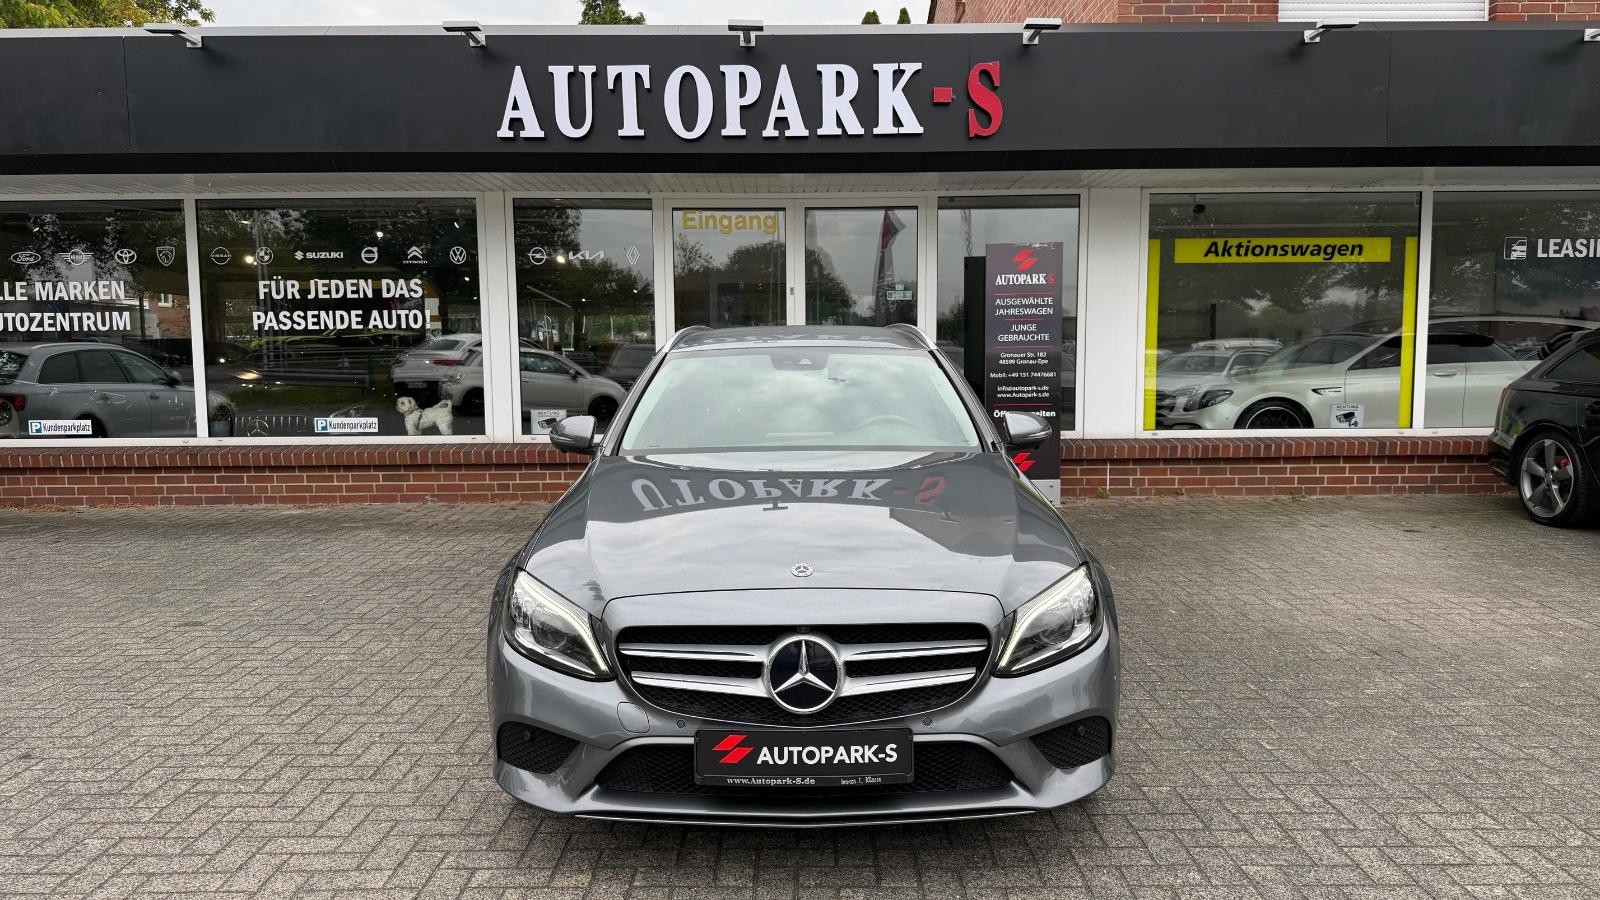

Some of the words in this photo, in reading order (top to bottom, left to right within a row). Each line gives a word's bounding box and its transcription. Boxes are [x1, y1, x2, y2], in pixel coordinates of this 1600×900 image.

[496, 61, 1004, 140] AUTOPARK-S
[682, 209, 778, 234] Eingang
[306, 251, 344, 259] SUZUKI
[1203, 240, 1364, 263] Aktionswagen
[1537, 238, 1600, 258] LEASI
[0, 281, 29, 301] LE
[35, 280, 126, 301] MARKEN
[258, 275, 301, 300] FÜR
[307, 278, 373, 300] JEDEN
[381, 277, 423, 299] DAS
[995, 297, 1054, 306] AUSGEWÄHLTE
[995, 307, 1054, 316] JAHRESWAGEN
[252, 310, 364, 331] PASSENDE
[368, 308, 432, 330] AUTO!
[1011, 323, 1037, 332] JUNGE
[997, 333, 1050, 342] GEBRAUCHTE
[43, 422, 91, 433] Kundenparkplatz
[329, 420, 377, 431] Kundenparkplatz
[756, 743, 898, 765] AUTOPARK-S
[726, 777, 816, 787] www.Autopark-S.de
